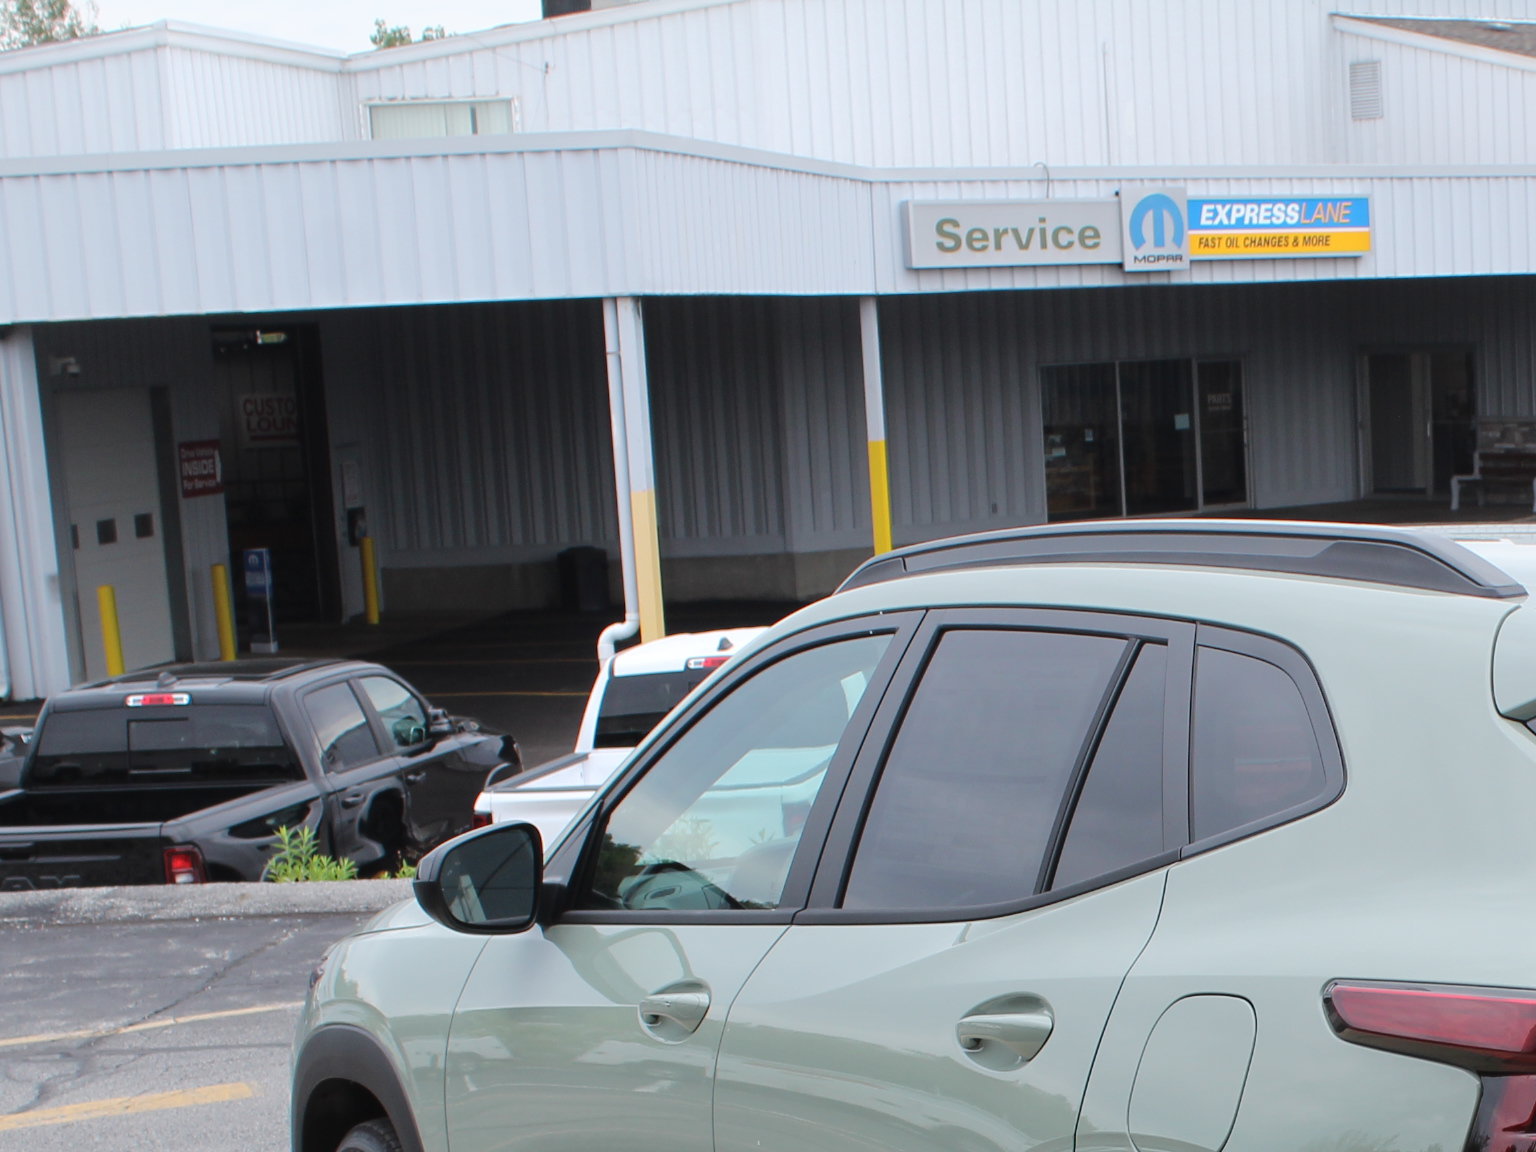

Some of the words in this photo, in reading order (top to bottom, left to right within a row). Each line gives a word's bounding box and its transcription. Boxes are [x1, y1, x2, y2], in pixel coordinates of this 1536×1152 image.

[934, 217, 1102, 254] Service
[1198, 236, 1222, 249] FAST
[1225, 236, 1241, 249] OIL
[1242, 235, 1290, 248] CHANGES
[1291, 235, 1299, 248] &
[1301, 234, 1331, 247] MORE
[1133, 254, 1184, 265] MOPAR
[243, 398, 297, 416] CUSTO
[246, 417, 297, 433] LOUN
[181, 458, 215, 476] INSIDE
